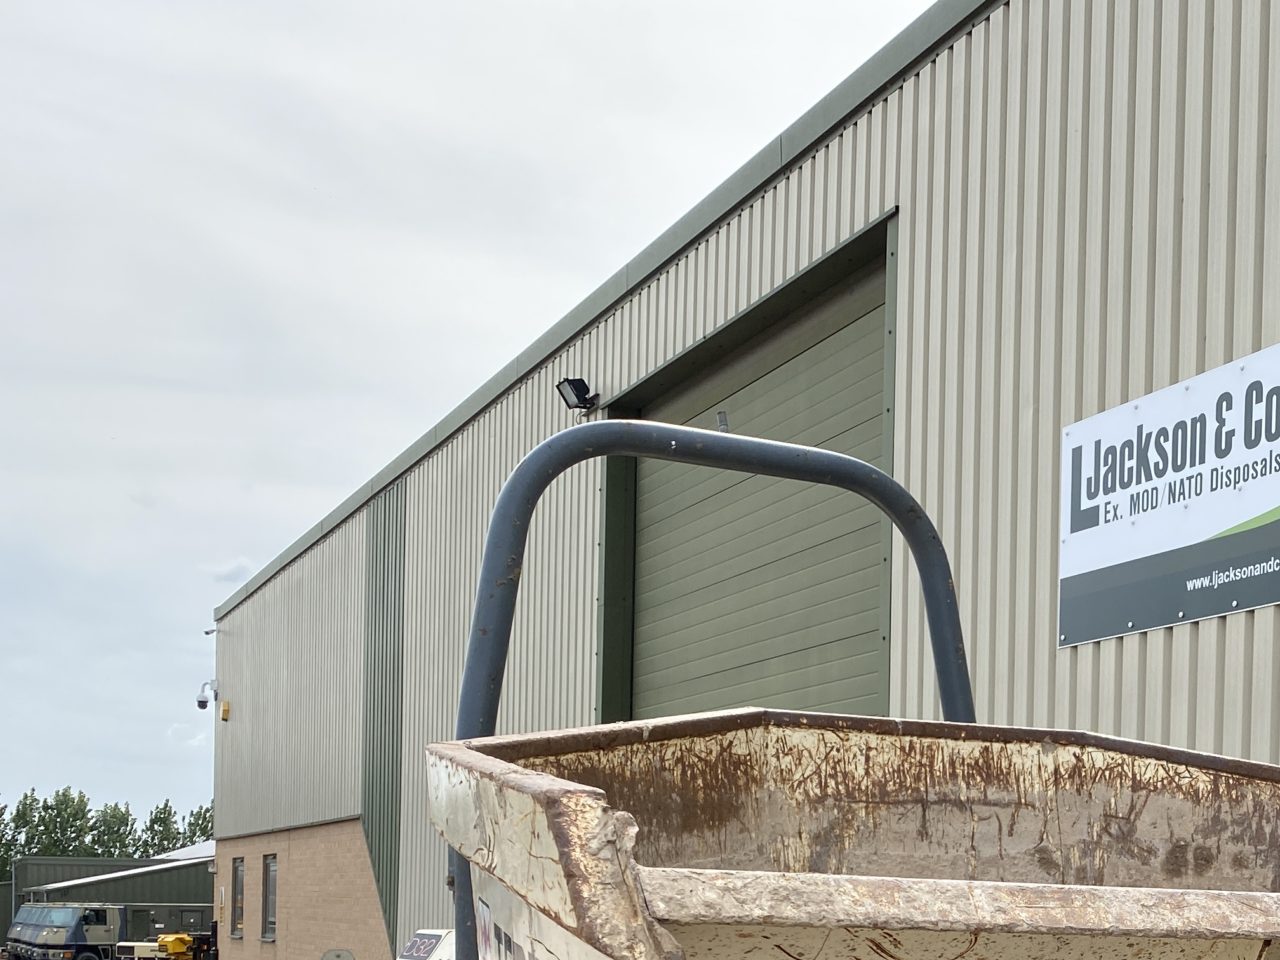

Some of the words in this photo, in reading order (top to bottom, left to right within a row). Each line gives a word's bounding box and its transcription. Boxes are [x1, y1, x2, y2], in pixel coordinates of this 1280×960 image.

[1213, 391, 1237, 459] &
[1103, 500, 1124, 525] Ex.
[1129, 472, 1203, 517] MOD/NATO
